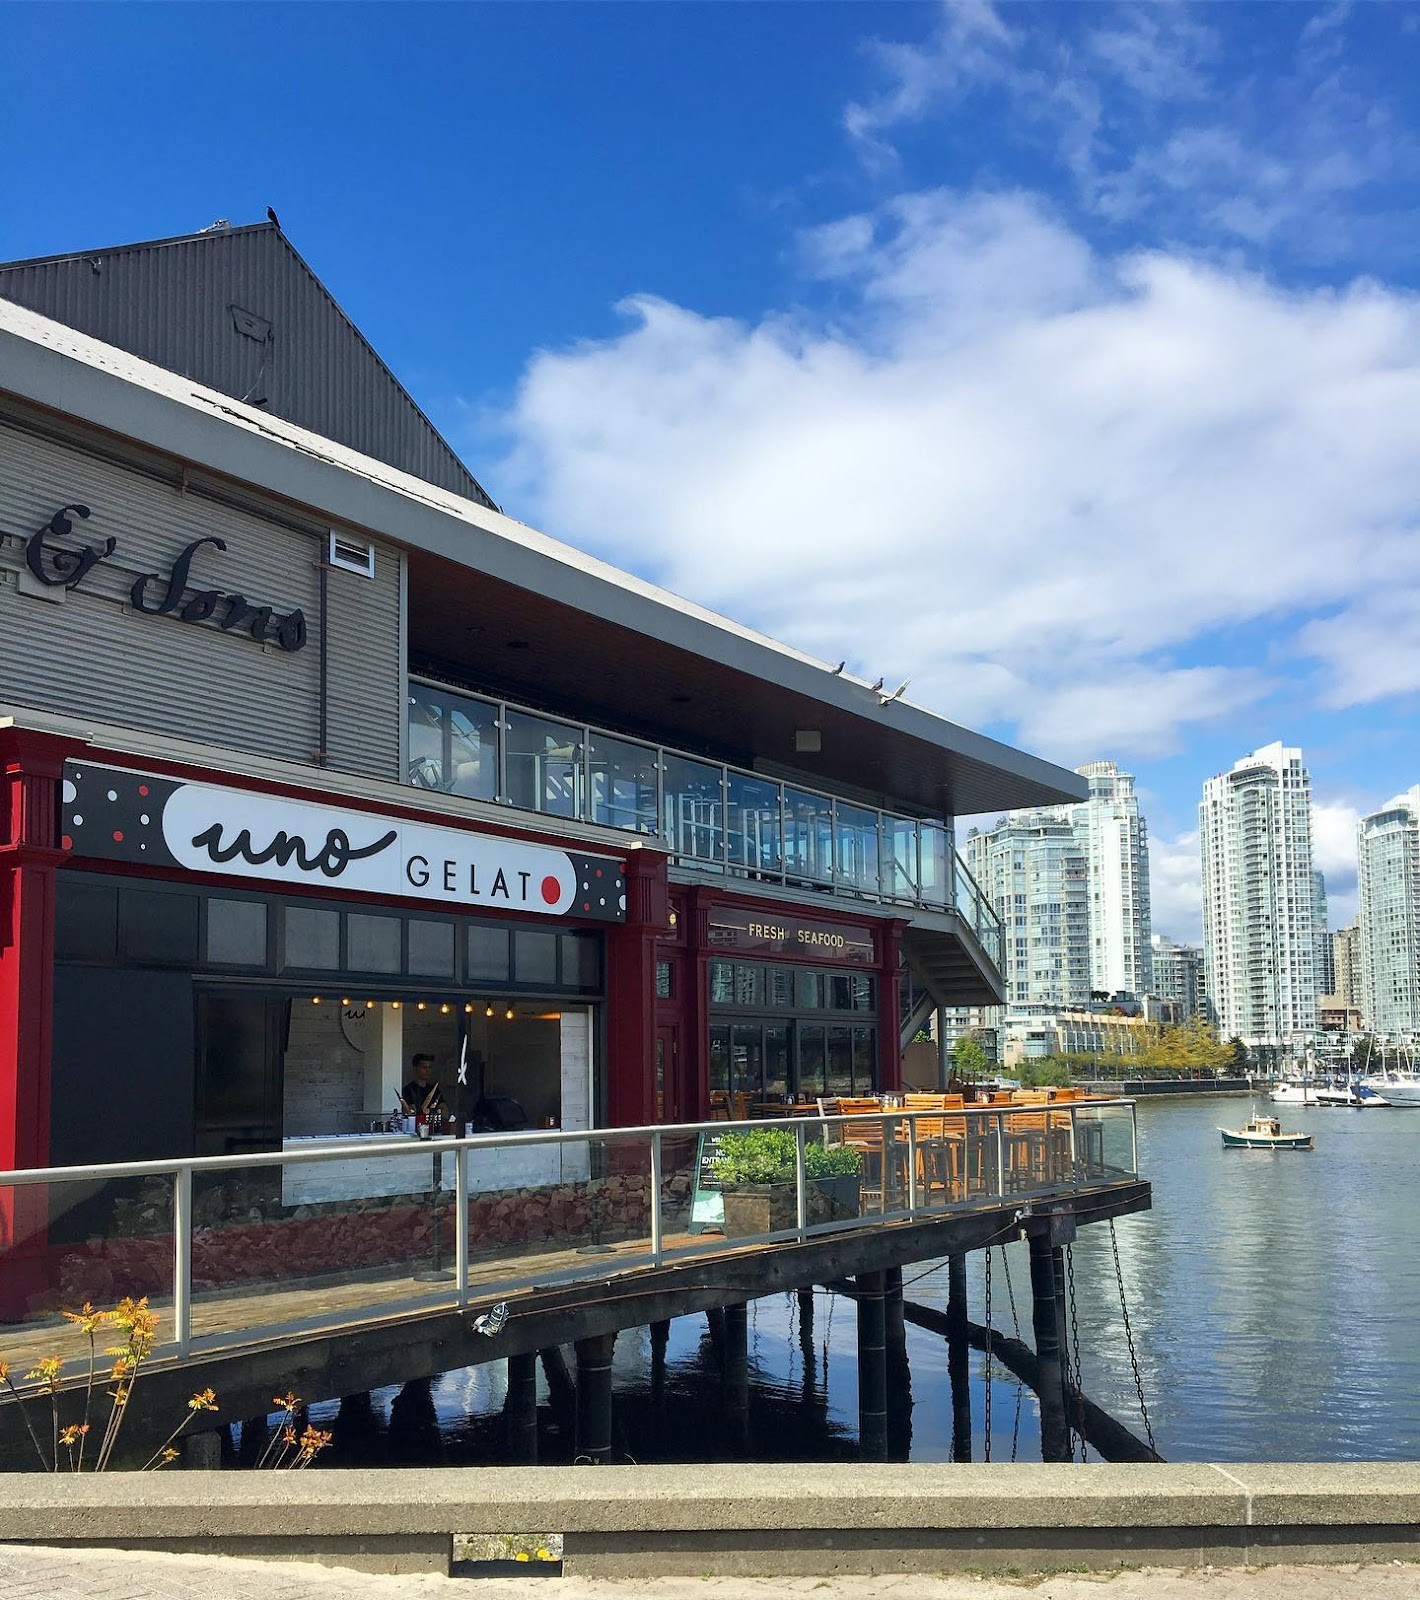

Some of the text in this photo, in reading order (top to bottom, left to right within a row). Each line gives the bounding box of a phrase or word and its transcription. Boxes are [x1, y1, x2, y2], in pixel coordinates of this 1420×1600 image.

[26, 504, 307, 652] & Sons
[192, 822, 398, 878] uno
[749, 923, 844, 947] FRESH SEAFOOD
